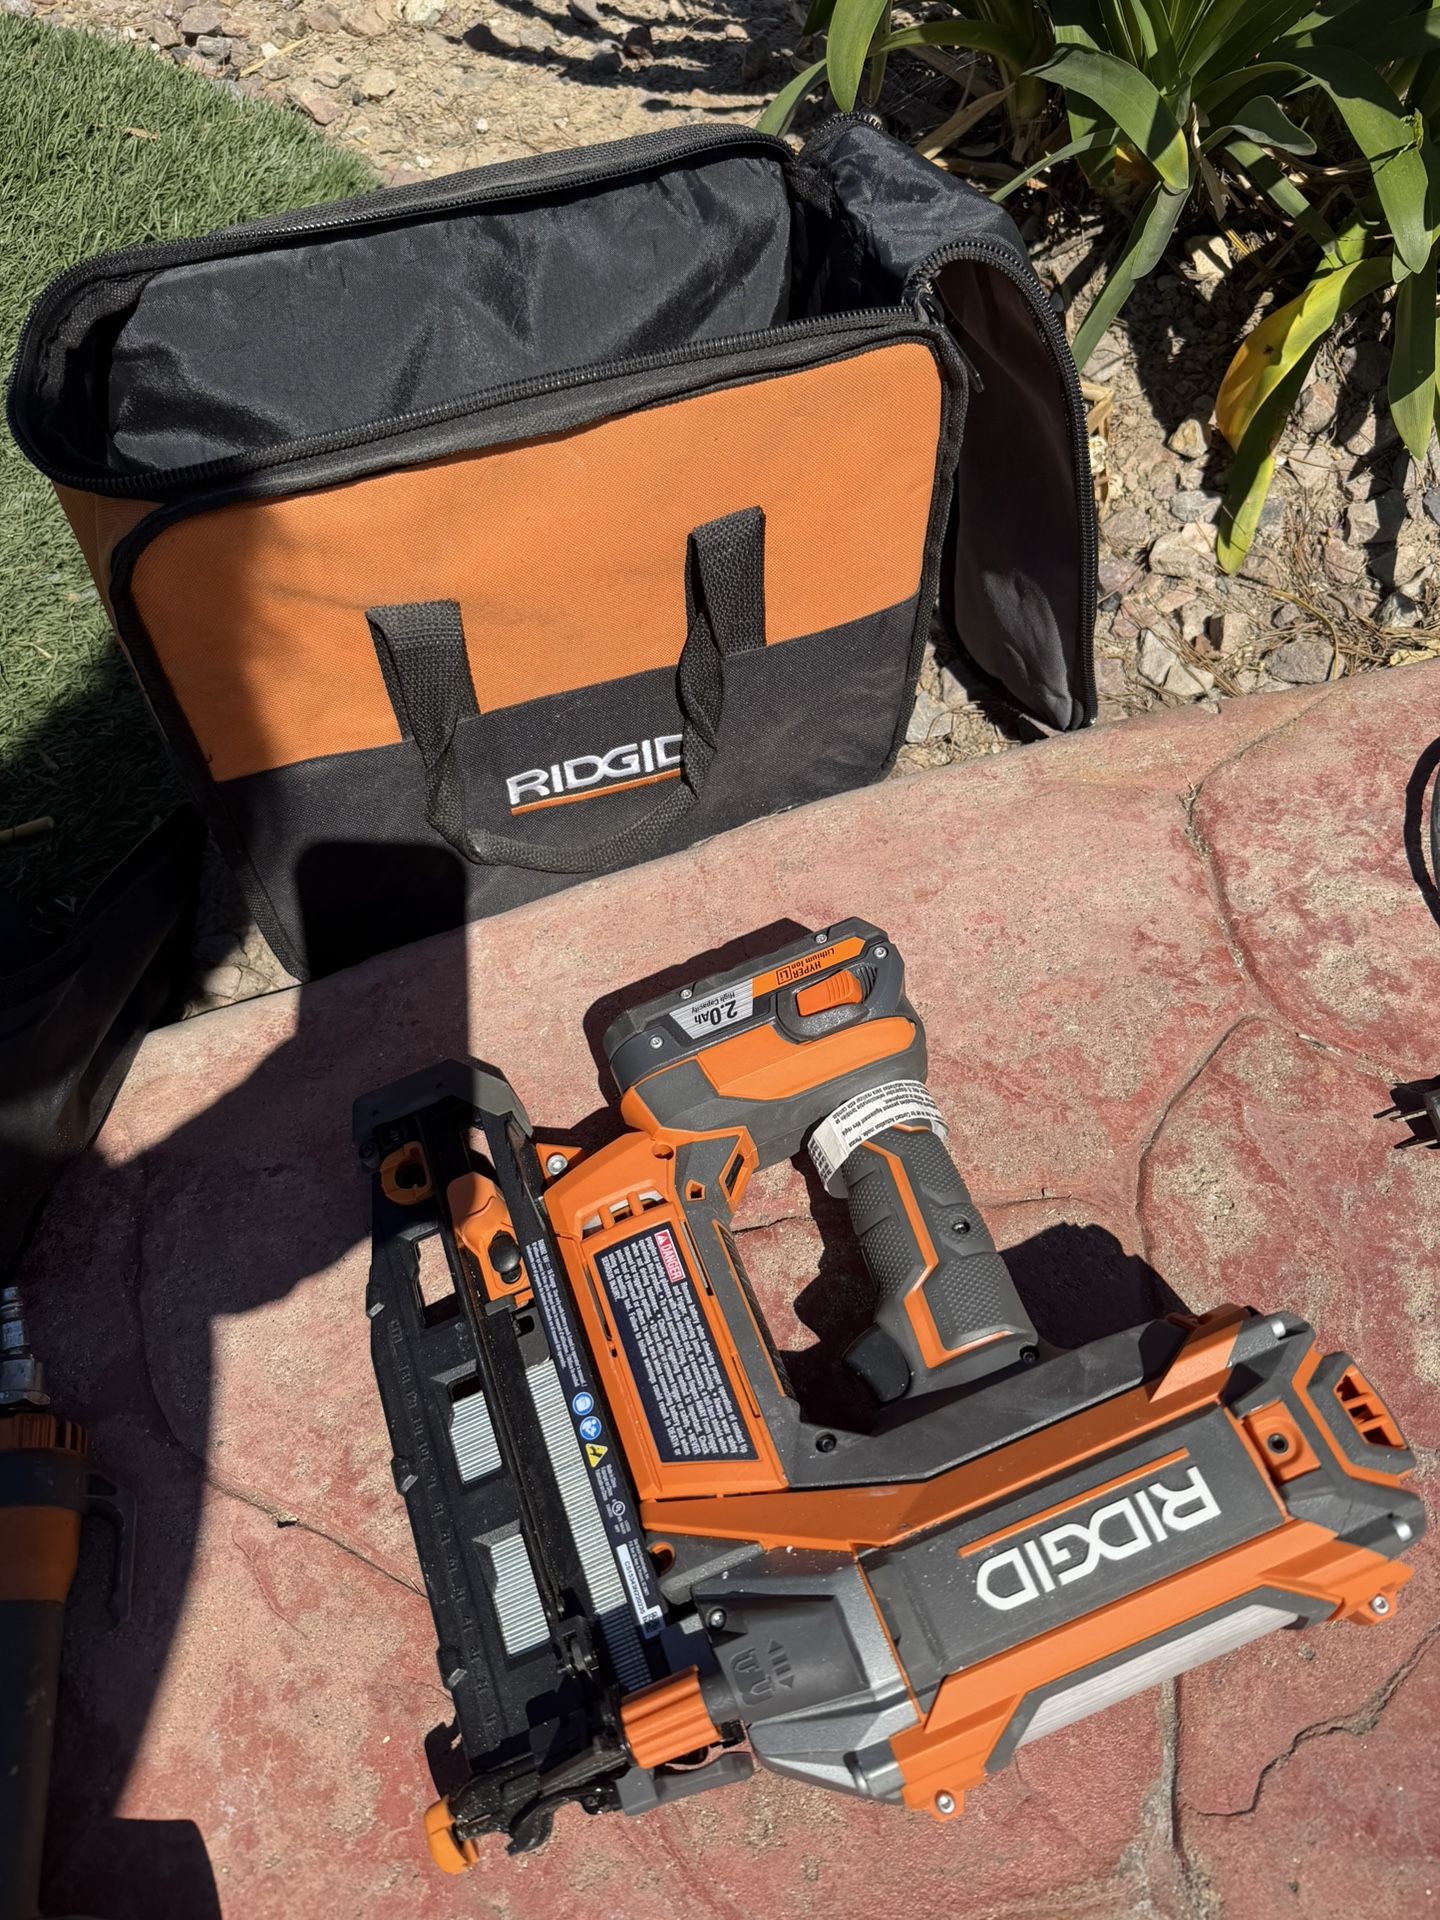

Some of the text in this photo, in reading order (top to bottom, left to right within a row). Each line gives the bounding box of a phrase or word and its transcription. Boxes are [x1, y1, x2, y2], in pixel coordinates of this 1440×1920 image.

[506, 734, 683, 806] RIDGID
[779, 960, 821, 981] HYPER Li
[791, 947, 835, 970] Lithium Ion
[691, 991, 736, 1014] High Capacity
[694, 999, 738, 1026] 2.0Ah
[660, 1243, 682, 1279] DANGER
[976, 1466, 1222, 1610] RIDGID
